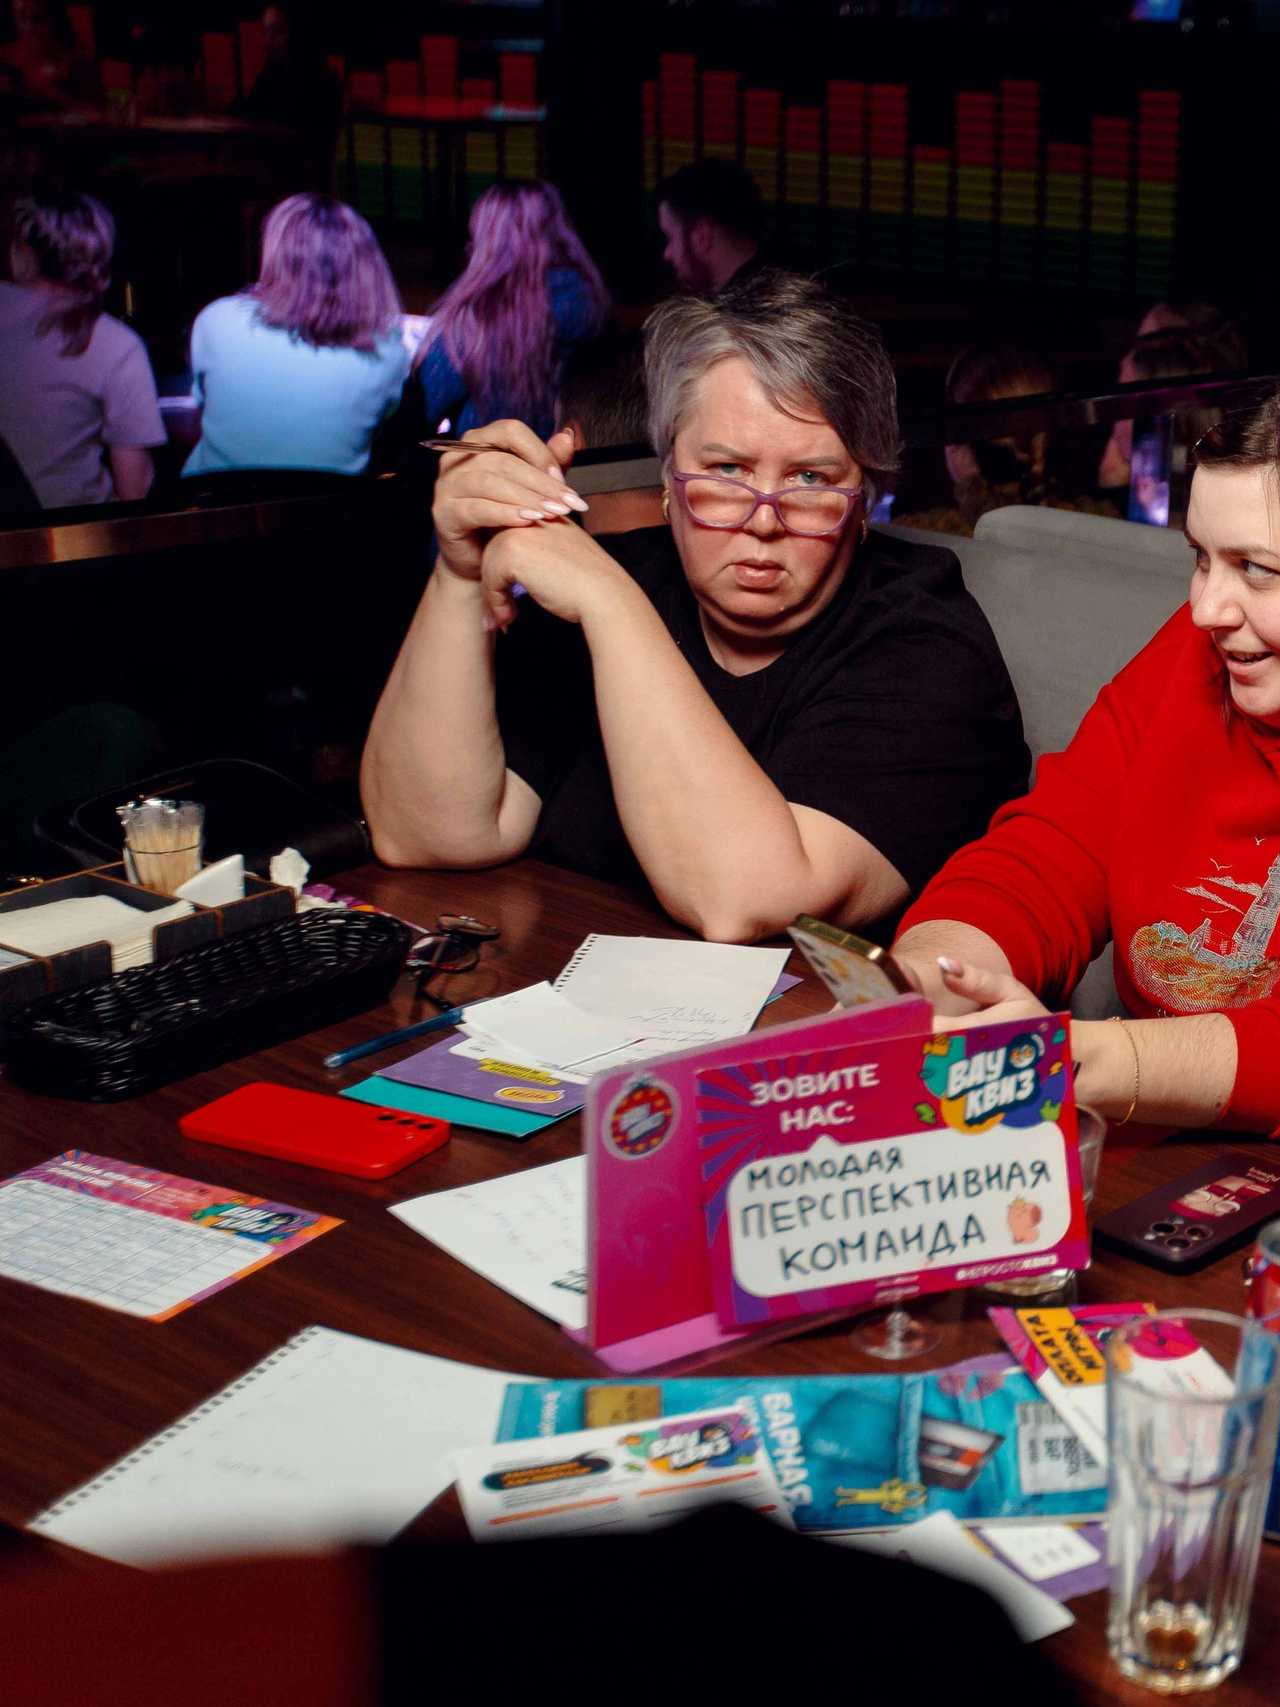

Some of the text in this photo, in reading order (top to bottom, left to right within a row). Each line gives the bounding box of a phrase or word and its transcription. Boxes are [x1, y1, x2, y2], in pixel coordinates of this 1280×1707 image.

[750, 1063, 881, 1107] ЗОВИТЕ
[947, 1047, 1007, 1099] ВАУ
[965, 1068, 1038, 1121] КВИЗ
[779, 1102, 856, 1134] НАС:
[747, 1146, 905, 1194] МОЛОДАЯ
[740, 1159, 1053, 1239] ПЕРСПЕКТИВНАЯ
[779, 1213, 986, 1282] КОМАНДА
